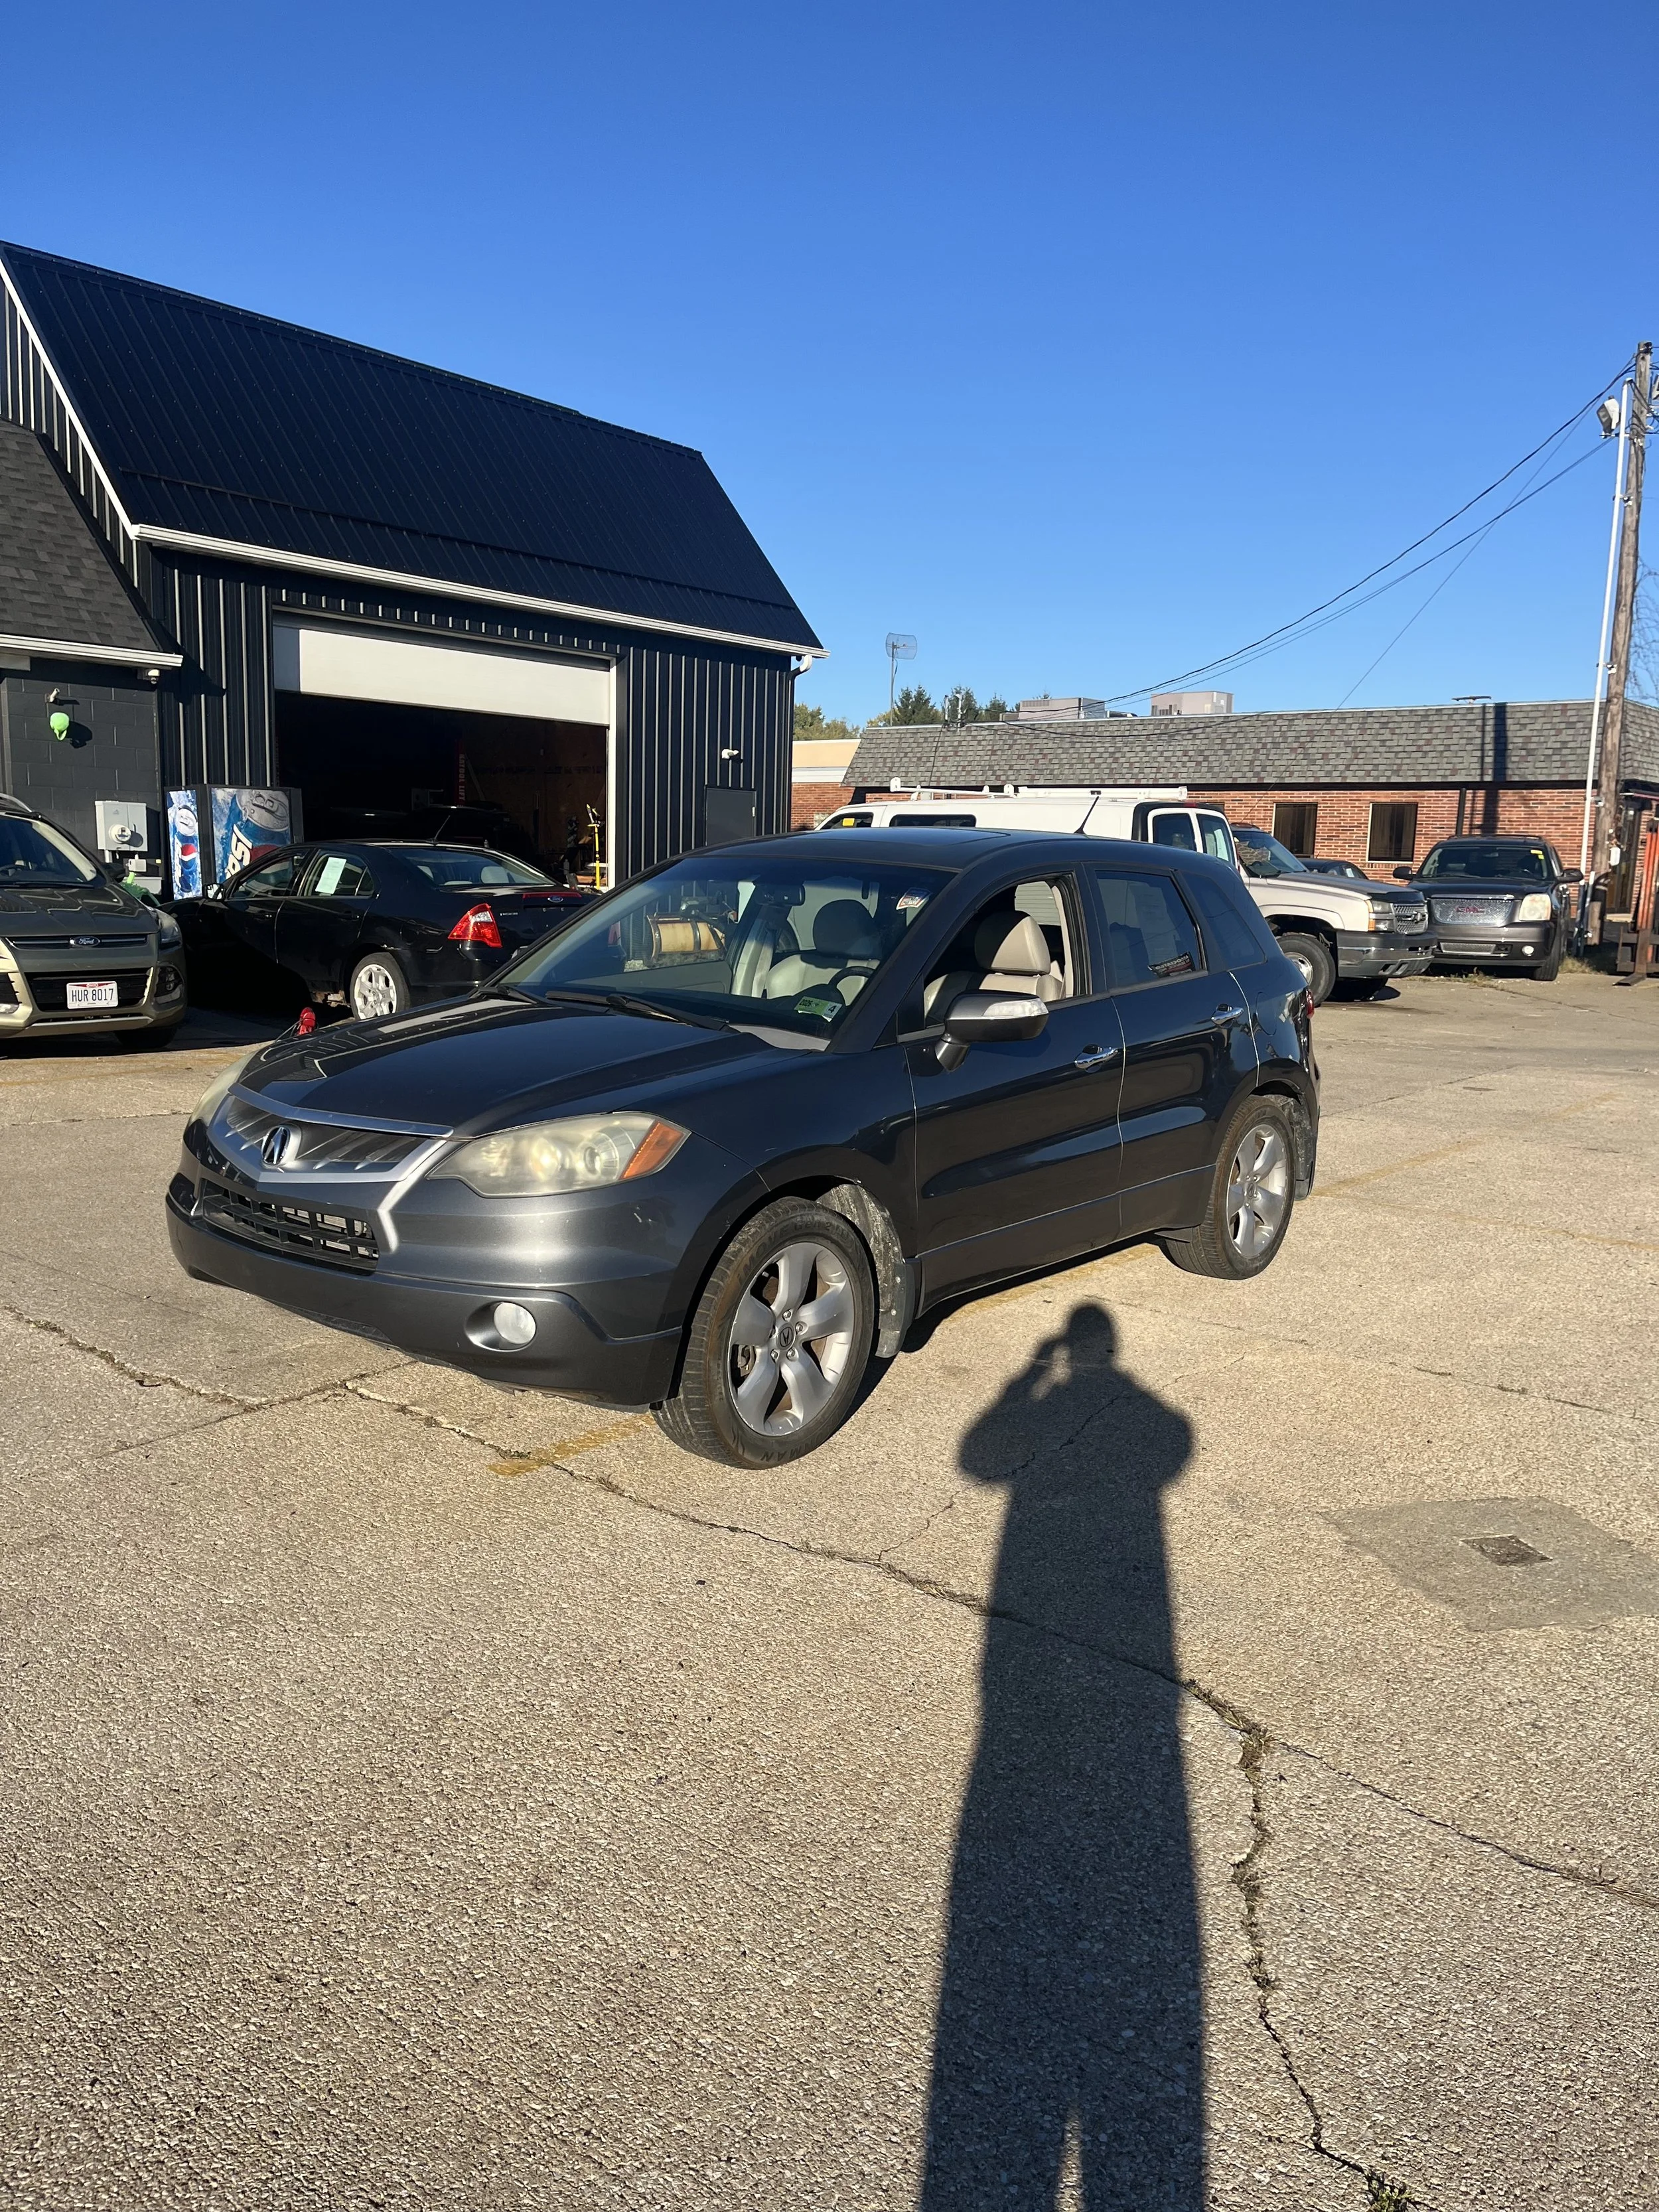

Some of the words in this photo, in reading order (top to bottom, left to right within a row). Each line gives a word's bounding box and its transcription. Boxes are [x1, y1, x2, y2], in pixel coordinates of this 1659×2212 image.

[226, 824, 252, 879] PSI
[72, 990, 88, 1002] HUR
[92, 988, 113, 1001] 8017
